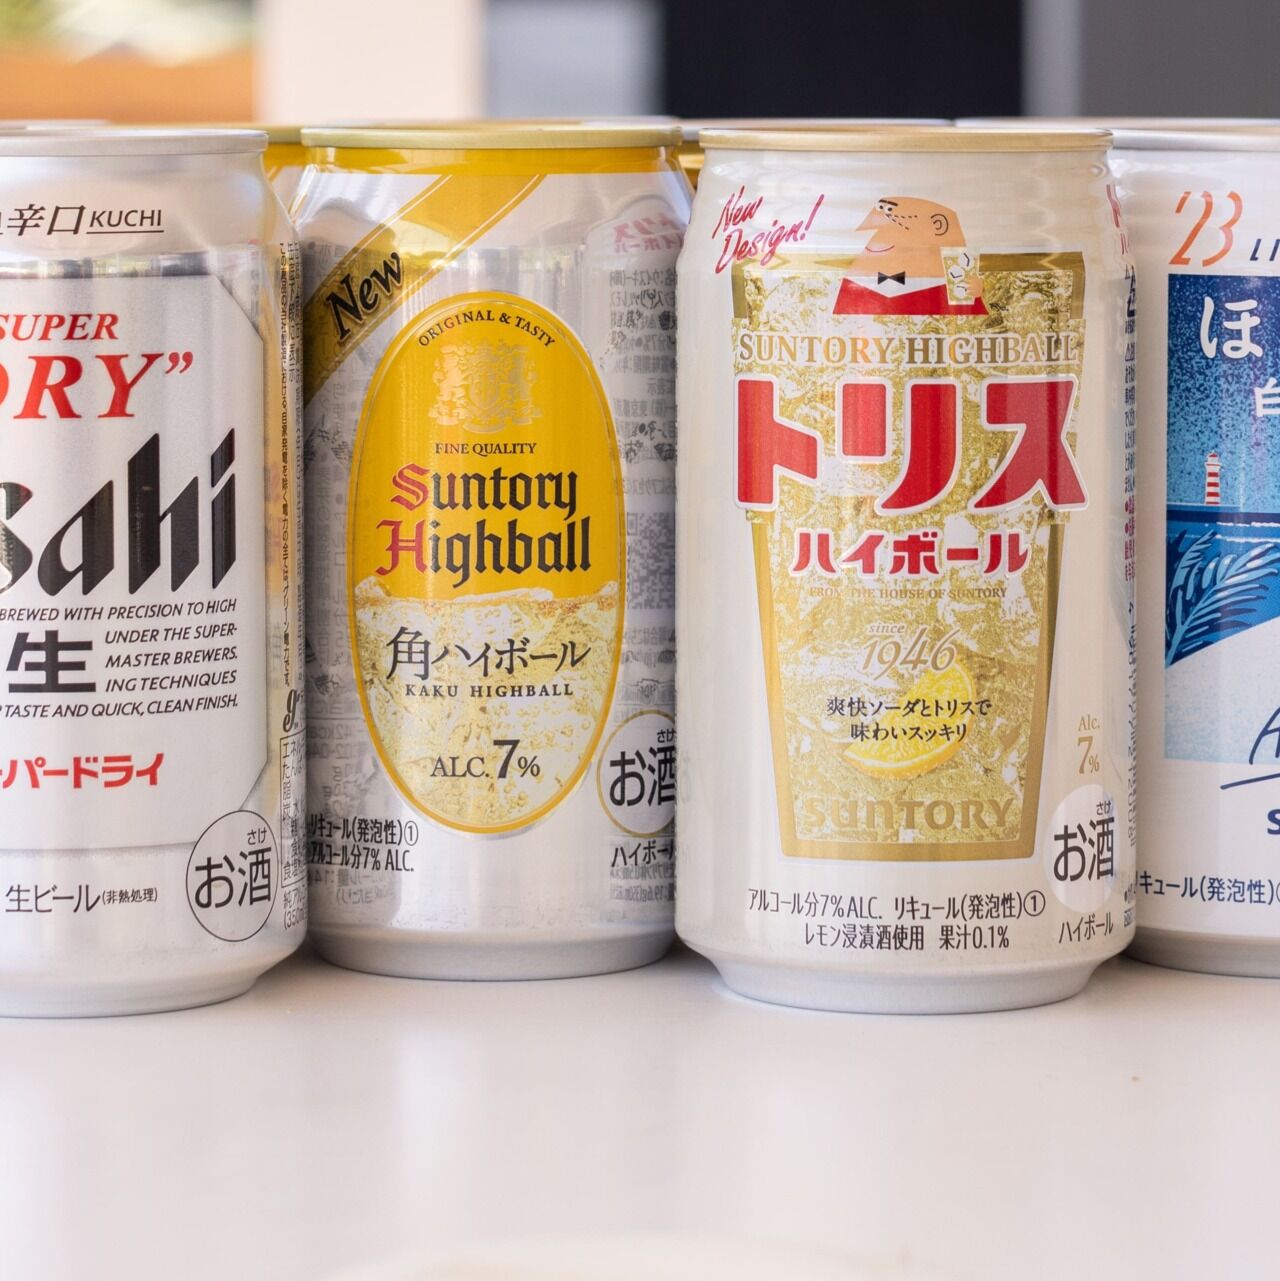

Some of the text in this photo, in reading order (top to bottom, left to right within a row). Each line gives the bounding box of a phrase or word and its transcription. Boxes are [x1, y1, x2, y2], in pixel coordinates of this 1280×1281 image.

[7, 204, 86, 236] 辛口
[88, 209, 163, 229] KUCHI
[712, 185, 764, 239] New
[714, 193, 825, 275] Design!
[325, 249, 405, 342] New
[418, 308, 557, 349] ORIGINAL & TASTY
[739, 333, 1079, 367] SUNTORY HIGHBALL
[435, 442, 537, 457] FINE QUALITY
[735, 377, 1088, 512] トリス
[390, 463, 578, 521] Suntory
[375, 517, 592, 589] Highball
[792, 530, 1029, 577] ハイボール
[64, 607, 104, 621] WITH
[107, 603, 183, 620] PRECISION
[205, 598, 237, 615] HIGH
[880, 588, 924, 599] HOUSE
[928, 588, 946, 599] OF
[949, 588, 1008, 600] SUNTORY
[105, 627, 191, 644] UNDER THE
[868, 622, 904, 634] since
[6, 629, 96, 693] 生
[105, 646, 237, 668] MASTER BREWERS.
[386, 626, 592, 681] 角ハイボール
[861, 625, 961, 681] 1946
[141, 669, 237, 691] TECHNIQUES
[405, 683, 573, 697] KAKU HIGHBALL
[4, 705, 51, 718] TASTE
[52, 704, 88, 718] AND
[147, 698, 194, 715] CLEAN
[826, 696, 994, 718] 爽快ソーダとトリスで
[1078, 715, 1101, 732] Alc.
[850, 723, 968, 742] 味わいスッキリ
[1077, 736, 1101, 775] 7%
[610, 745, 675, 807] お酒
[804, 798, 1015, 832] SUNTORY
[1096, 799, 1112, 815] さけ
[247, 827, 267, 845] さけ
[1053, 817, 1115, 883] お酒
[195, 847, 271, 908] お酒
[385, 849, 415, 872] ALC.
[804, 923, 1010, 951] レモン浸漬酒使用 果汁0.1%
[1058, 911, 1115, 945] ハイボール
